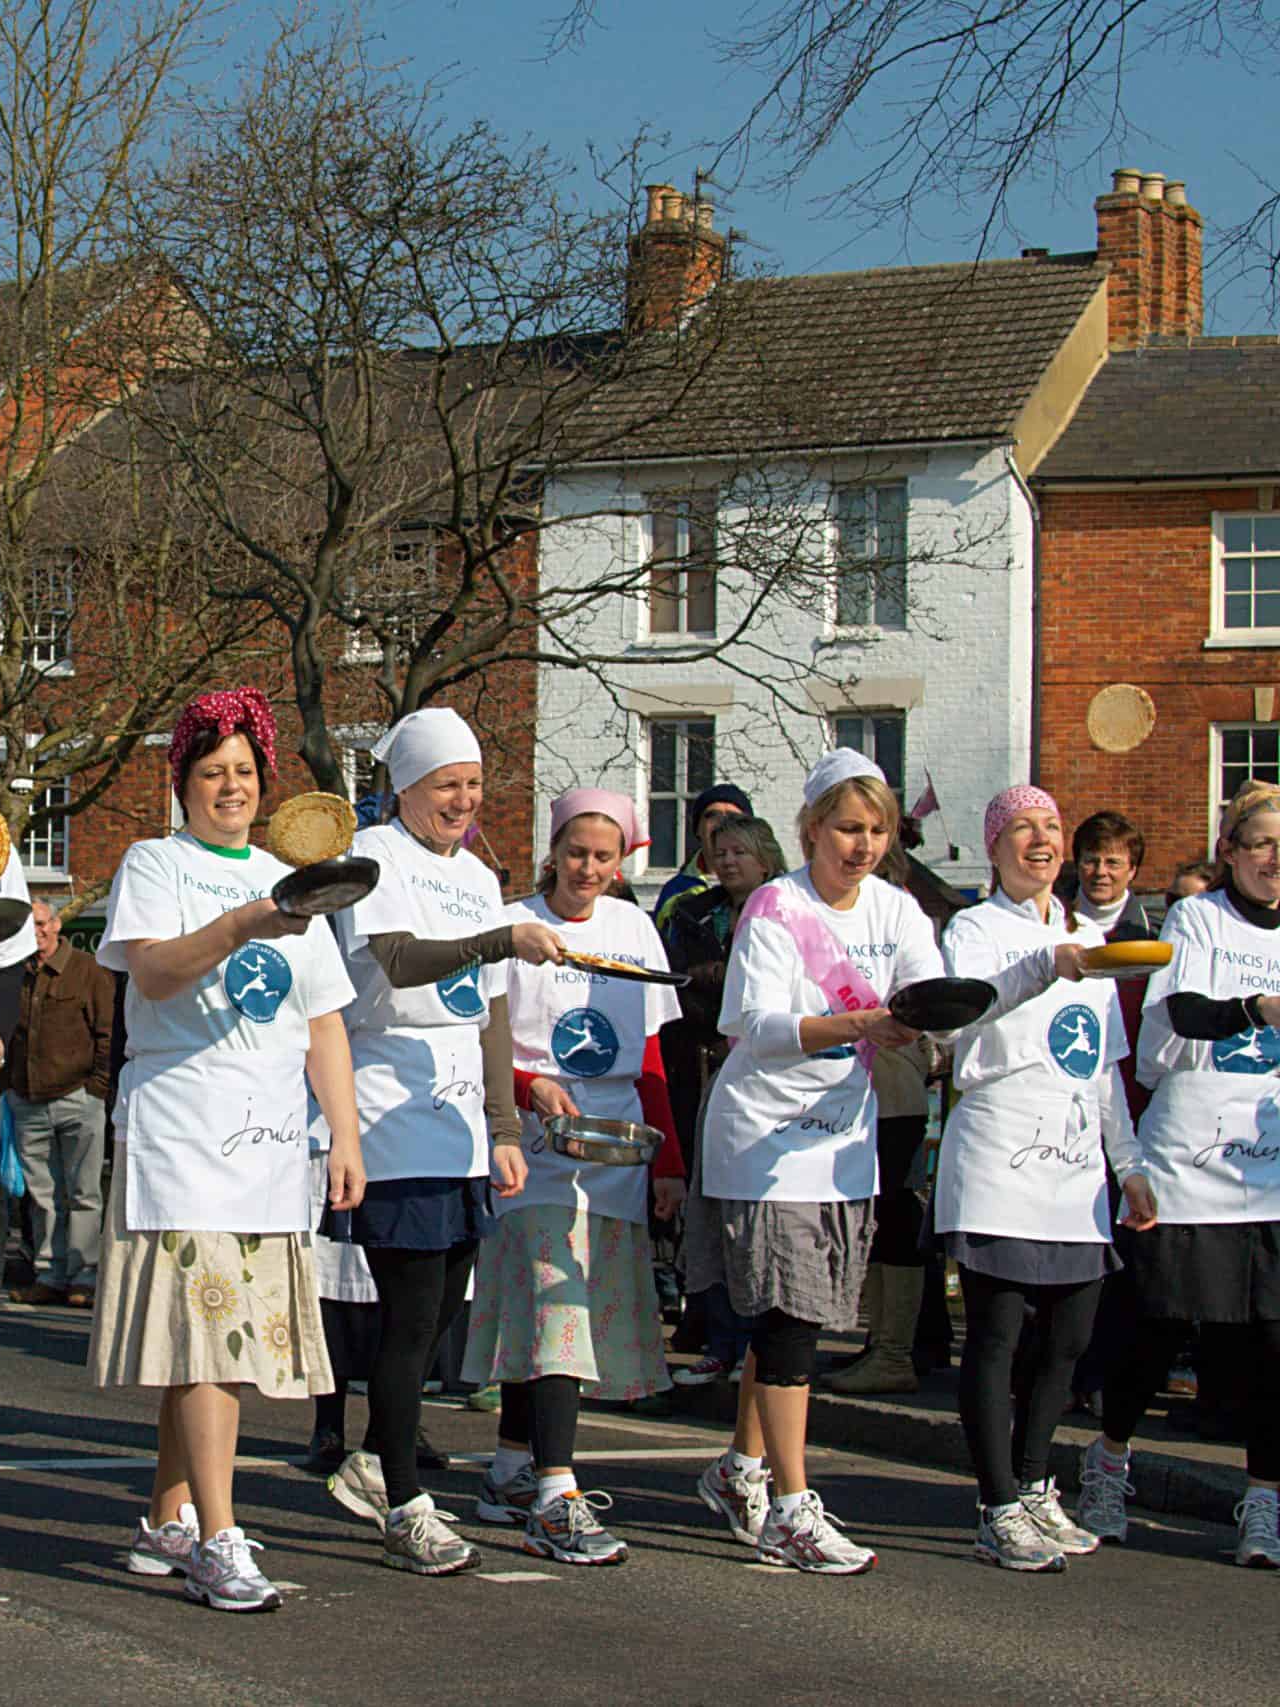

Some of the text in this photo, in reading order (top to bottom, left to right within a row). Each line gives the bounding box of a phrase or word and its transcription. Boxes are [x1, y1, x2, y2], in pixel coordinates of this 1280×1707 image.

[222, 1097, 301, 1157] joules
[1010, 1116, 1088, 1169] joules
[1193, 1116, 1280, 1168] joules
